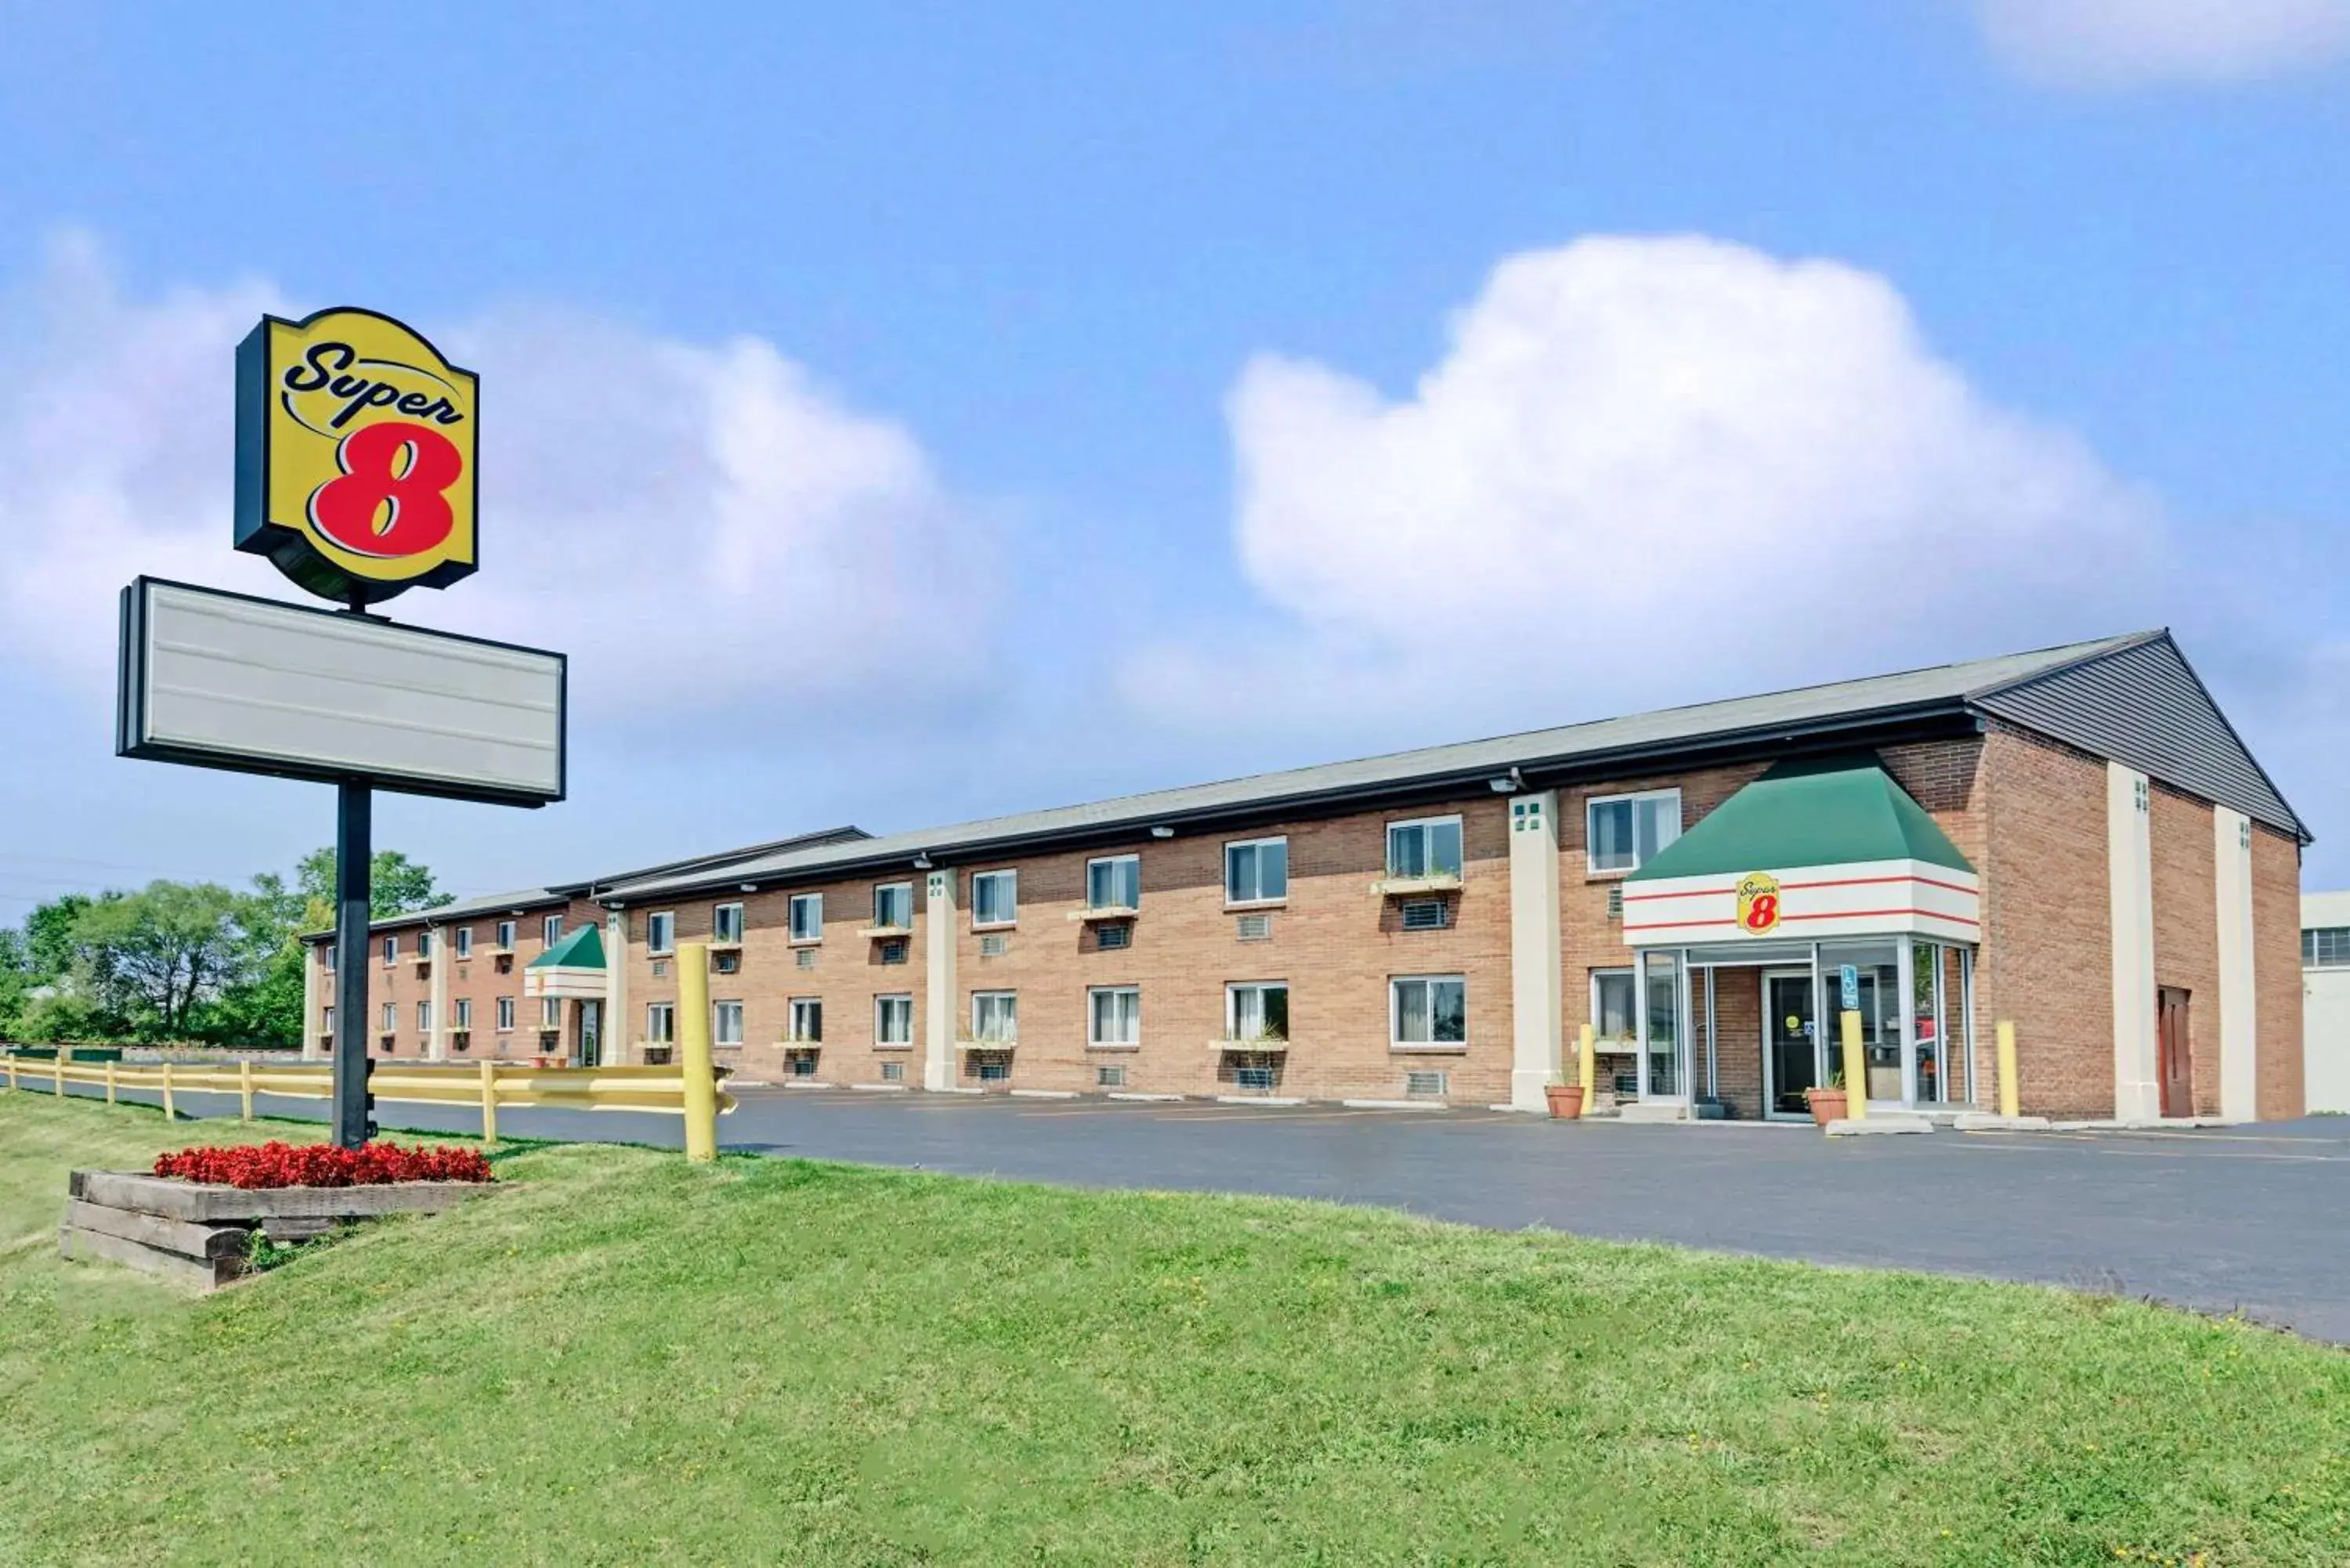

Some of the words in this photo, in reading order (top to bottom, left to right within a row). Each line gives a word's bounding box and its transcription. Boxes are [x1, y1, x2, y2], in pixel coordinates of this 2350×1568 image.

[284, 341, 465, 428] Super
[306, 422, 463, 558] 8
[1747, 894, 1777, 928] 8
